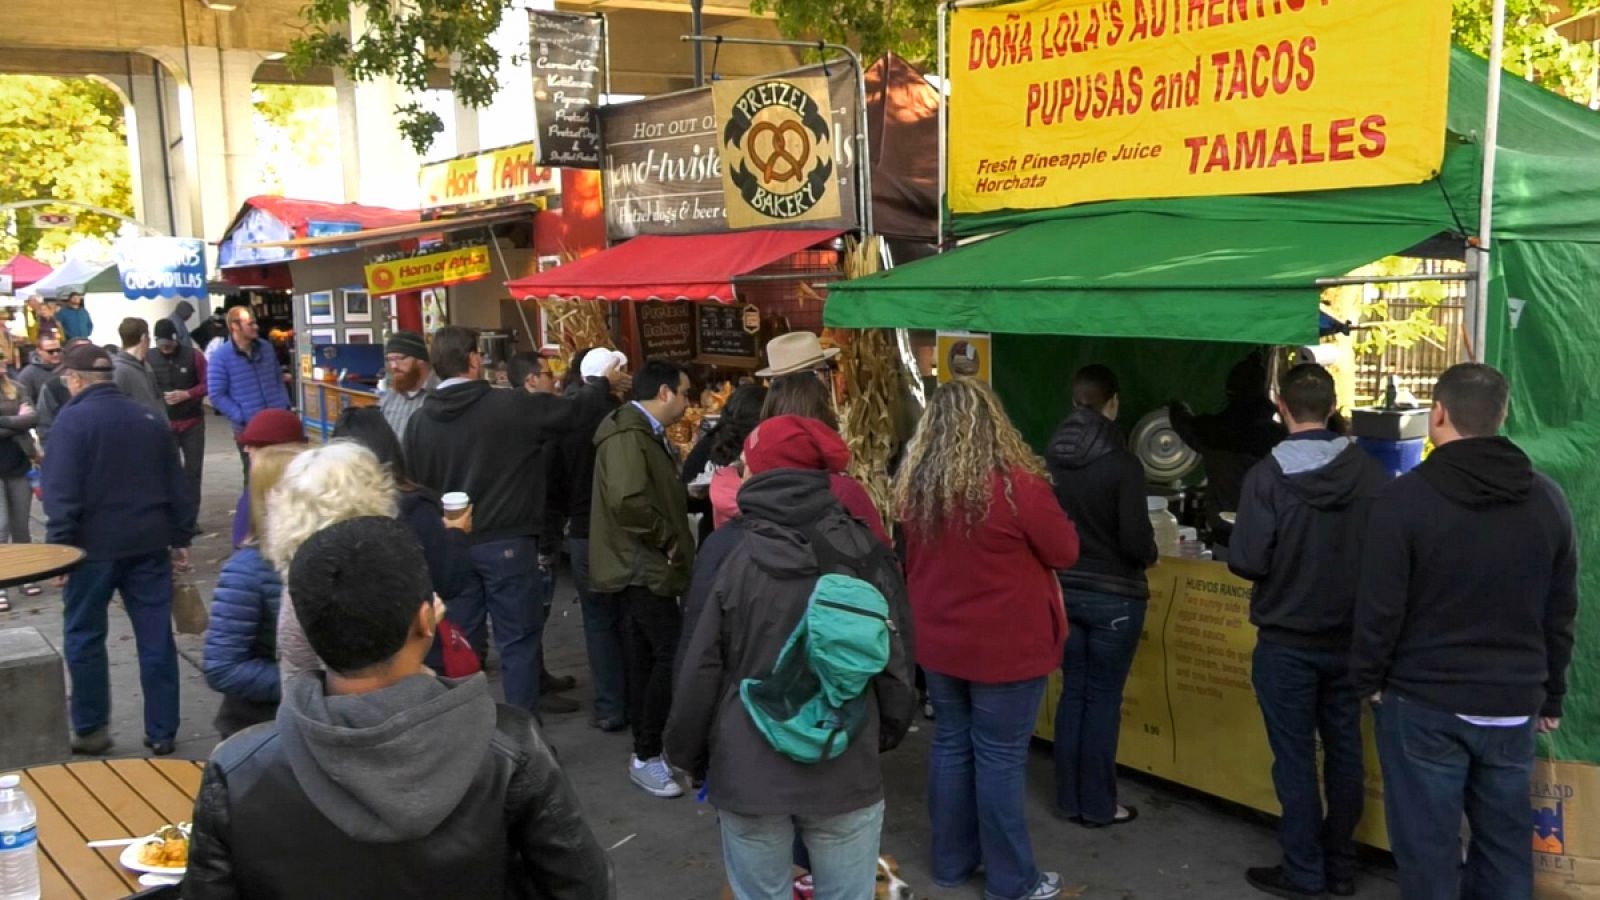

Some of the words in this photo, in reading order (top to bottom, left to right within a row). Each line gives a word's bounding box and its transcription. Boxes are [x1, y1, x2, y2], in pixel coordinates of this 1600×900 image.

[968, 12, 1033, 71] DOÑA
[1041, 0, 1125, 60] LOLA'S
[1128, 0, 1306, 42] AUTHEN
[1025, 65, 1144, 127] PUPUSAS
[1151, 56, 1200, 113] and
[1211, 36, 1317, 102] TACOS
[735, 82, 808, 121] PRETZEL
[632, 121, 664, 139] HOT
[668, 118, 699, 134] OUT
[1184, 115, 1387, 174] TAMALES
[501, 151, 552, 188] Africa
[976, 156, 1018, 176] Fresh
[1021, 147, 1108, 170] Pineapple
[1111, 142, 1163, 162] Juice
[752, 182, 816, 217] BAKERY
[975, 173, 1048, 194] Horchata
[692, 197, 721, 219] beer
[399, 263, 433, 279] Horn
[433, 258, 446, 272] of
[449, 253, 486, 270] Africa
[1185, 577, 1219, 593] HUEVOS
